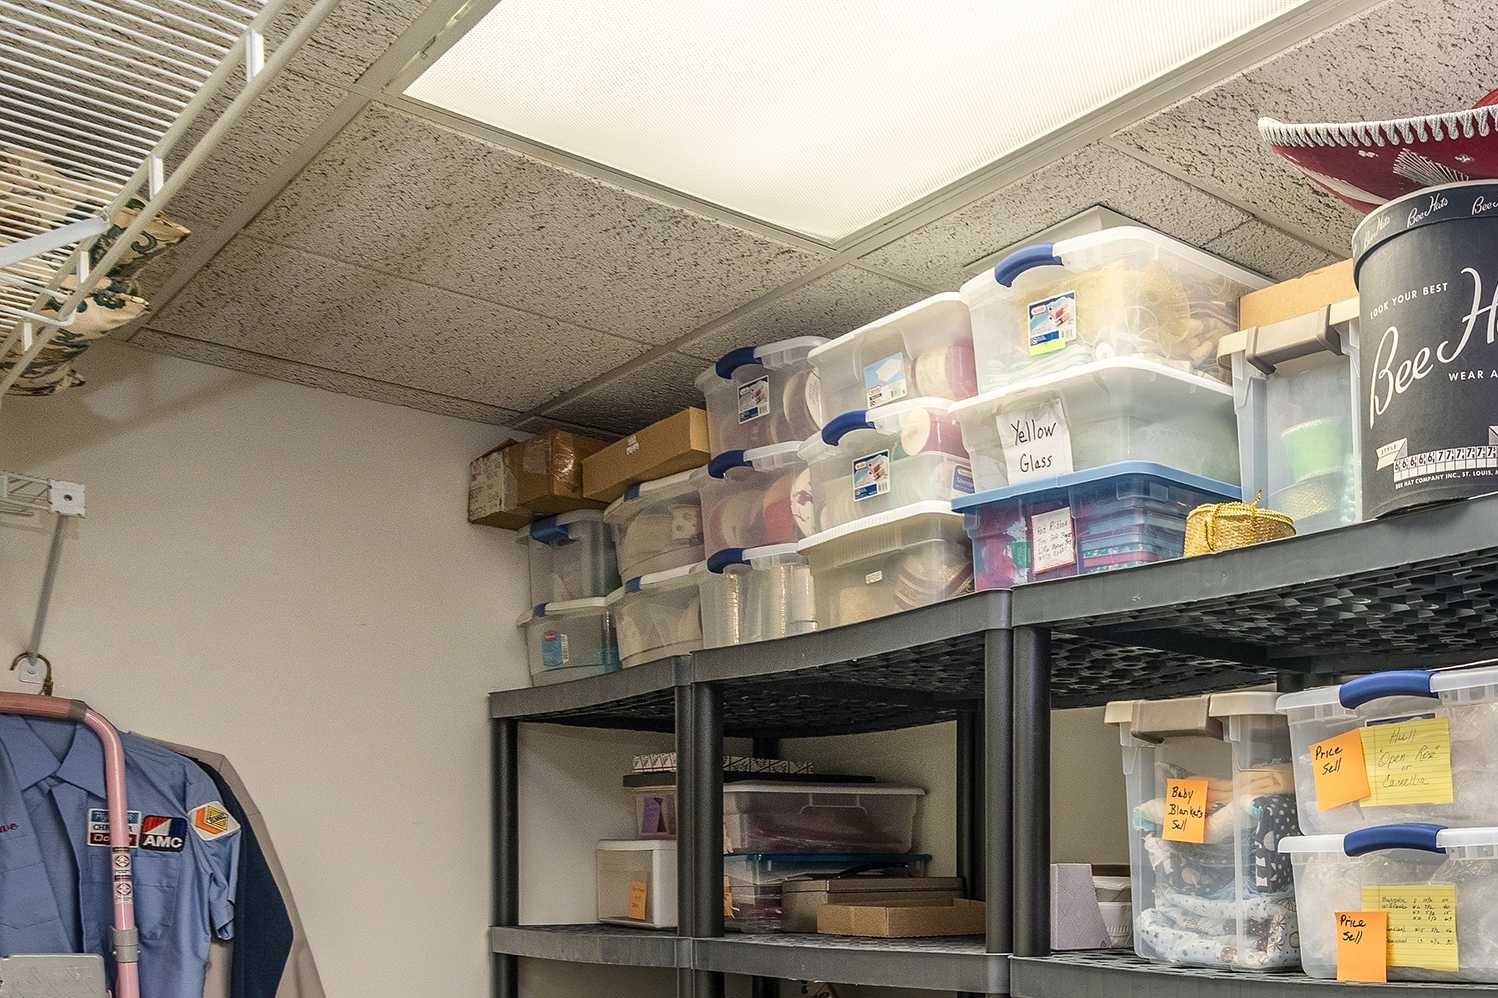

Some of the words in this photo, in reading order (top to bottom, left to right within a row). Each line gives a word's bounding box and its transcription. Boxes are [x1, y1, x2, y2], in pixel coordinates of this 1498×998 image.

[1407, 207, 1424, 228] Bee
[1423, 193, 1449, 217] Hats
[1471, 195, 1493, 216] Bee
[1369, 300, 1390, 320] LOOK
[1391, 289, 1418, 306] YOUR
[1422, 282, 1449, 296] BEST
[1370, 326, 1434, 430] Bee
[1449, 371, 1484, 382] WEAR
[1490, 369, 1498, 379] A
[1010, 418, 1057, 447] Yellow
[1019, 453, 1052, 473] Glass
[1415, 474, 1445, 484] COMPANY
[1389, 727, 1416, 744] Hull
[1315, 745, 1344, 761] Price
[1171, 786, 1194, 805] Baby
[1168, 804, 1205, 820] Blankets
[143, 835, 183, 848] AMC
[1340, 914, 1366, 928] Price
